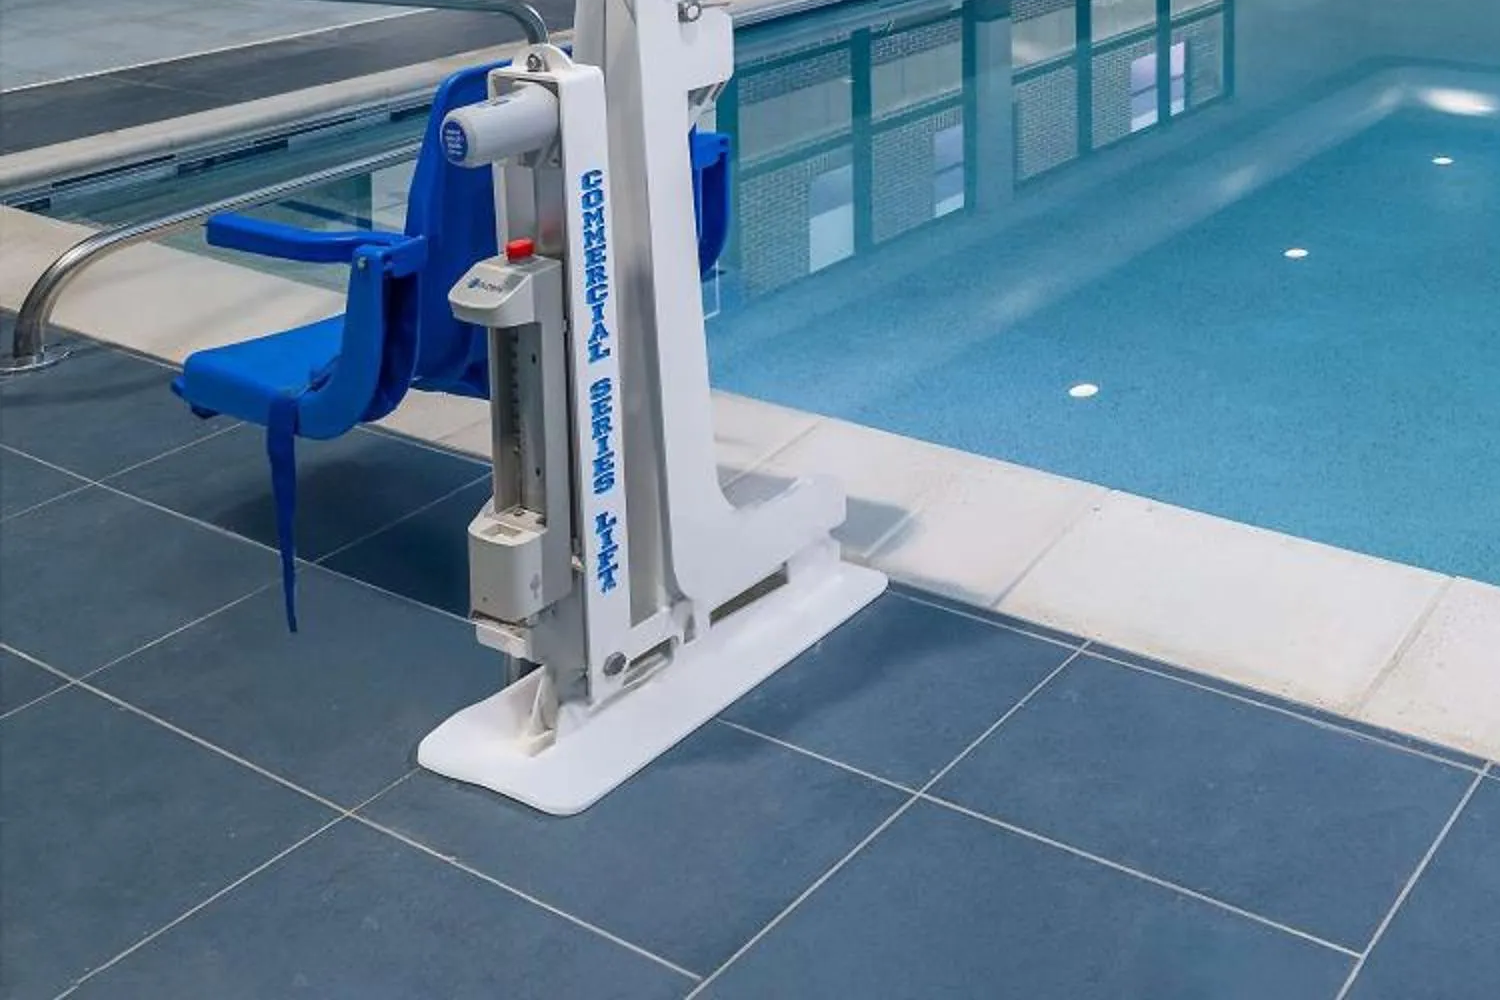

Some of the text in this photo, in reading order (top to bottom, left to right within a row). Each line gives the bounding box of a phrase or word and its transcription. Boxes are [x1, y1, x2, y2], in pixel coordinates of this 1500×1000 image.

[580, 170, 618, 593] COMMERCIAL SERIES LIFT
